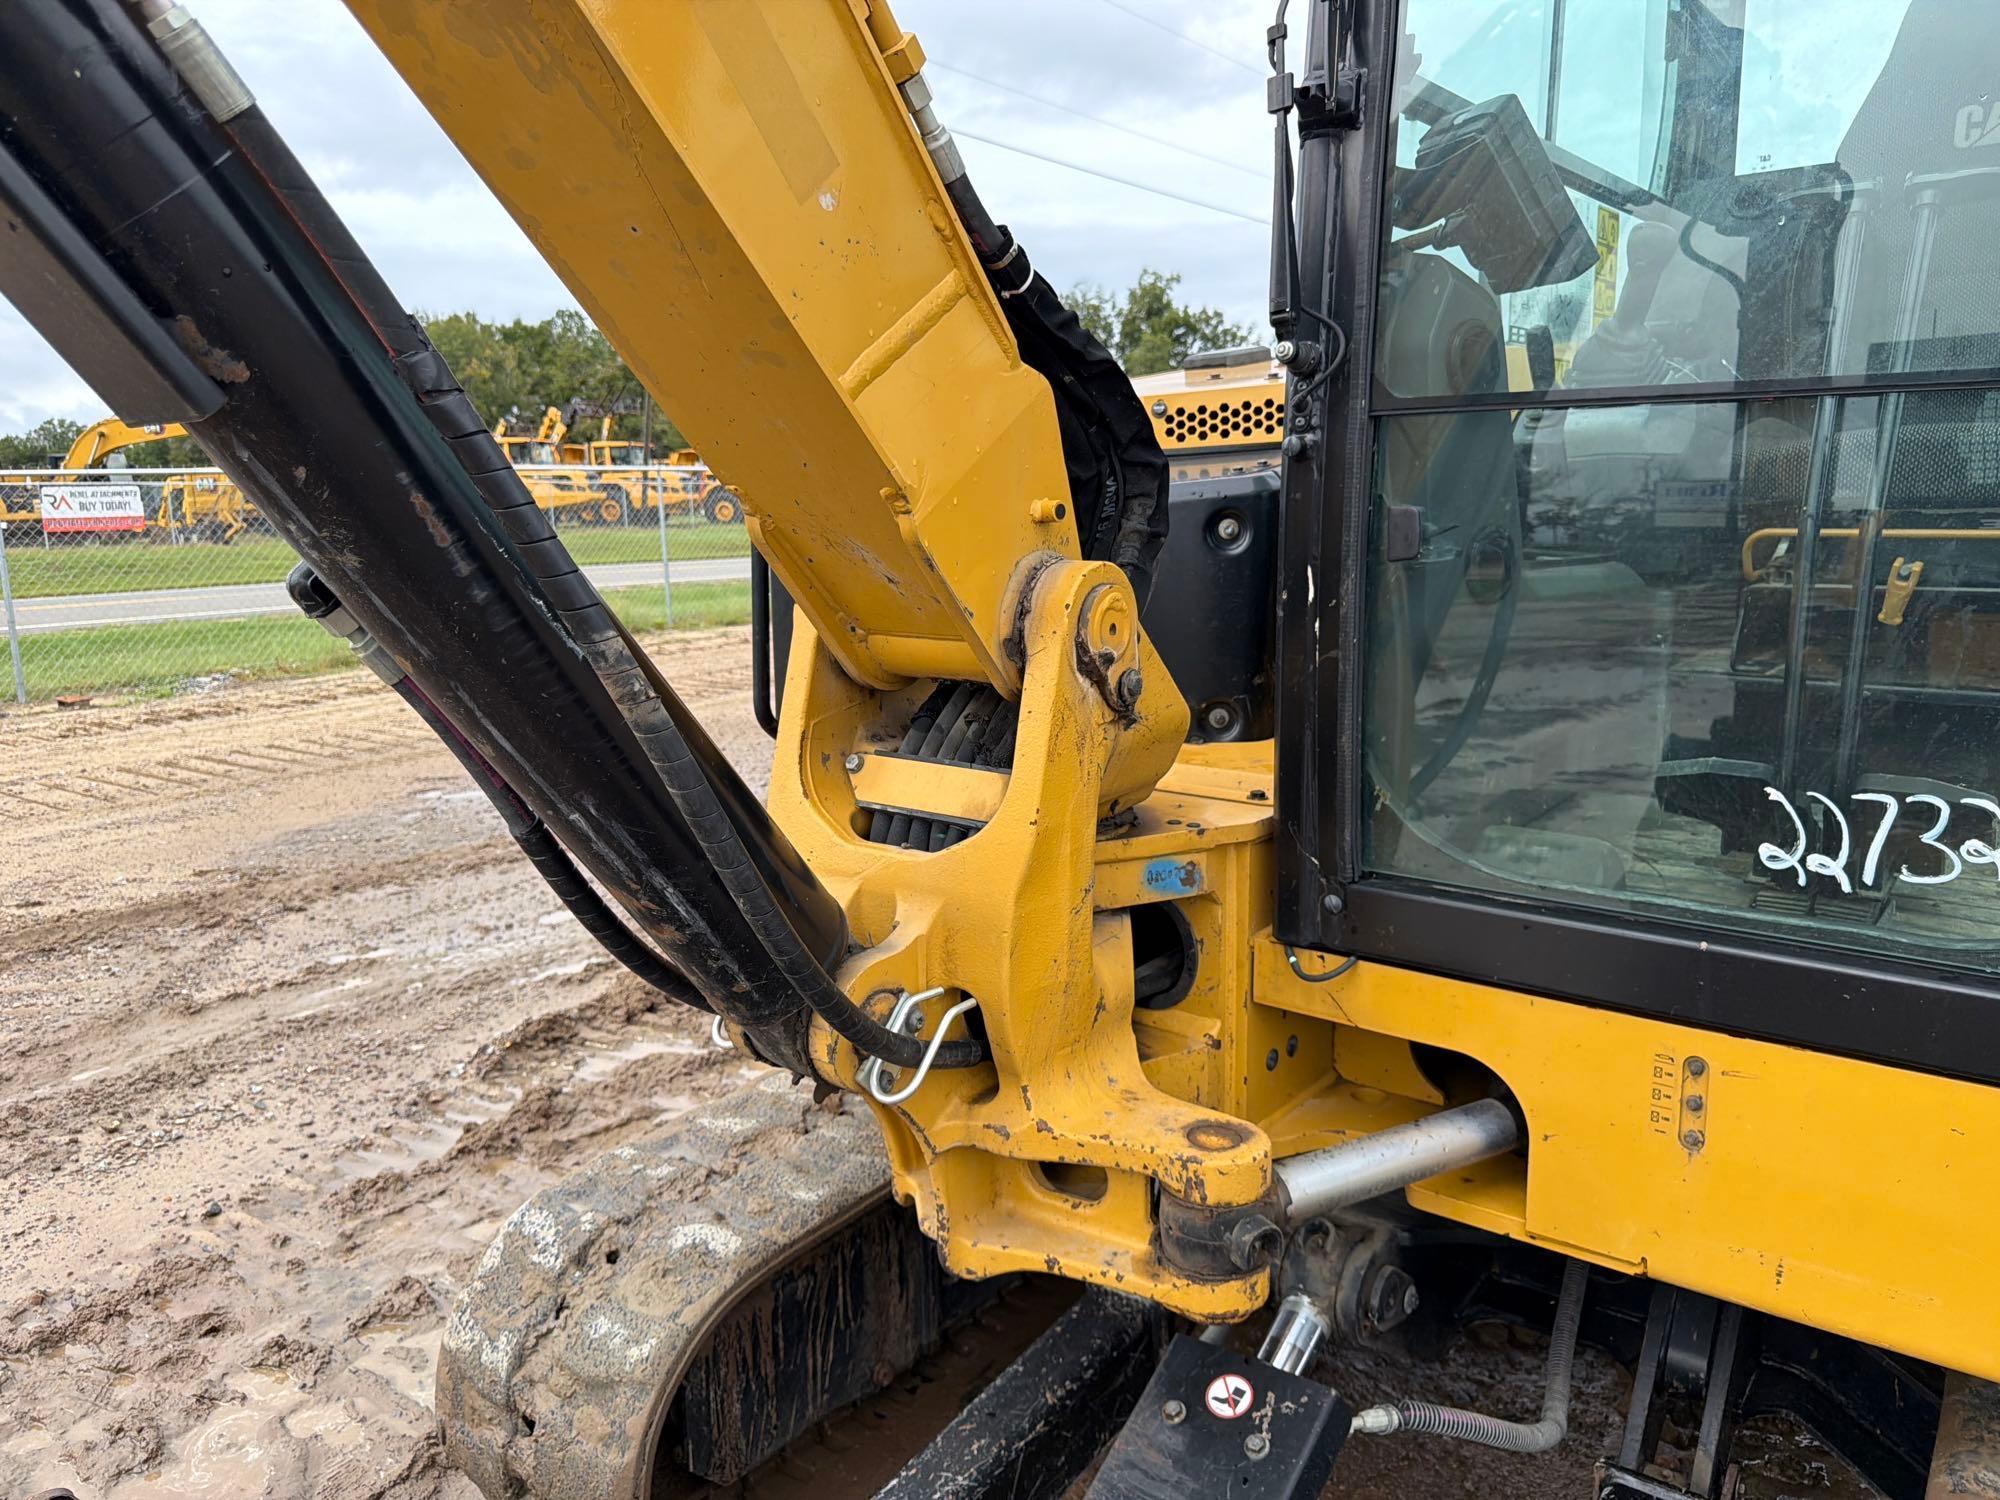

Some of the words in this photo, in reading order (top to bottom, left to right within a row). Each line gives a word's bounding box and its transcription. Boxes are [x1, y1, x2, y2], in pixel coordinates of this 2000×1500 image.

[196, 477, 215, 491] CAT
[78, 501, 97, 512] BUY
[100, 500, 132, 512] TODAY!
